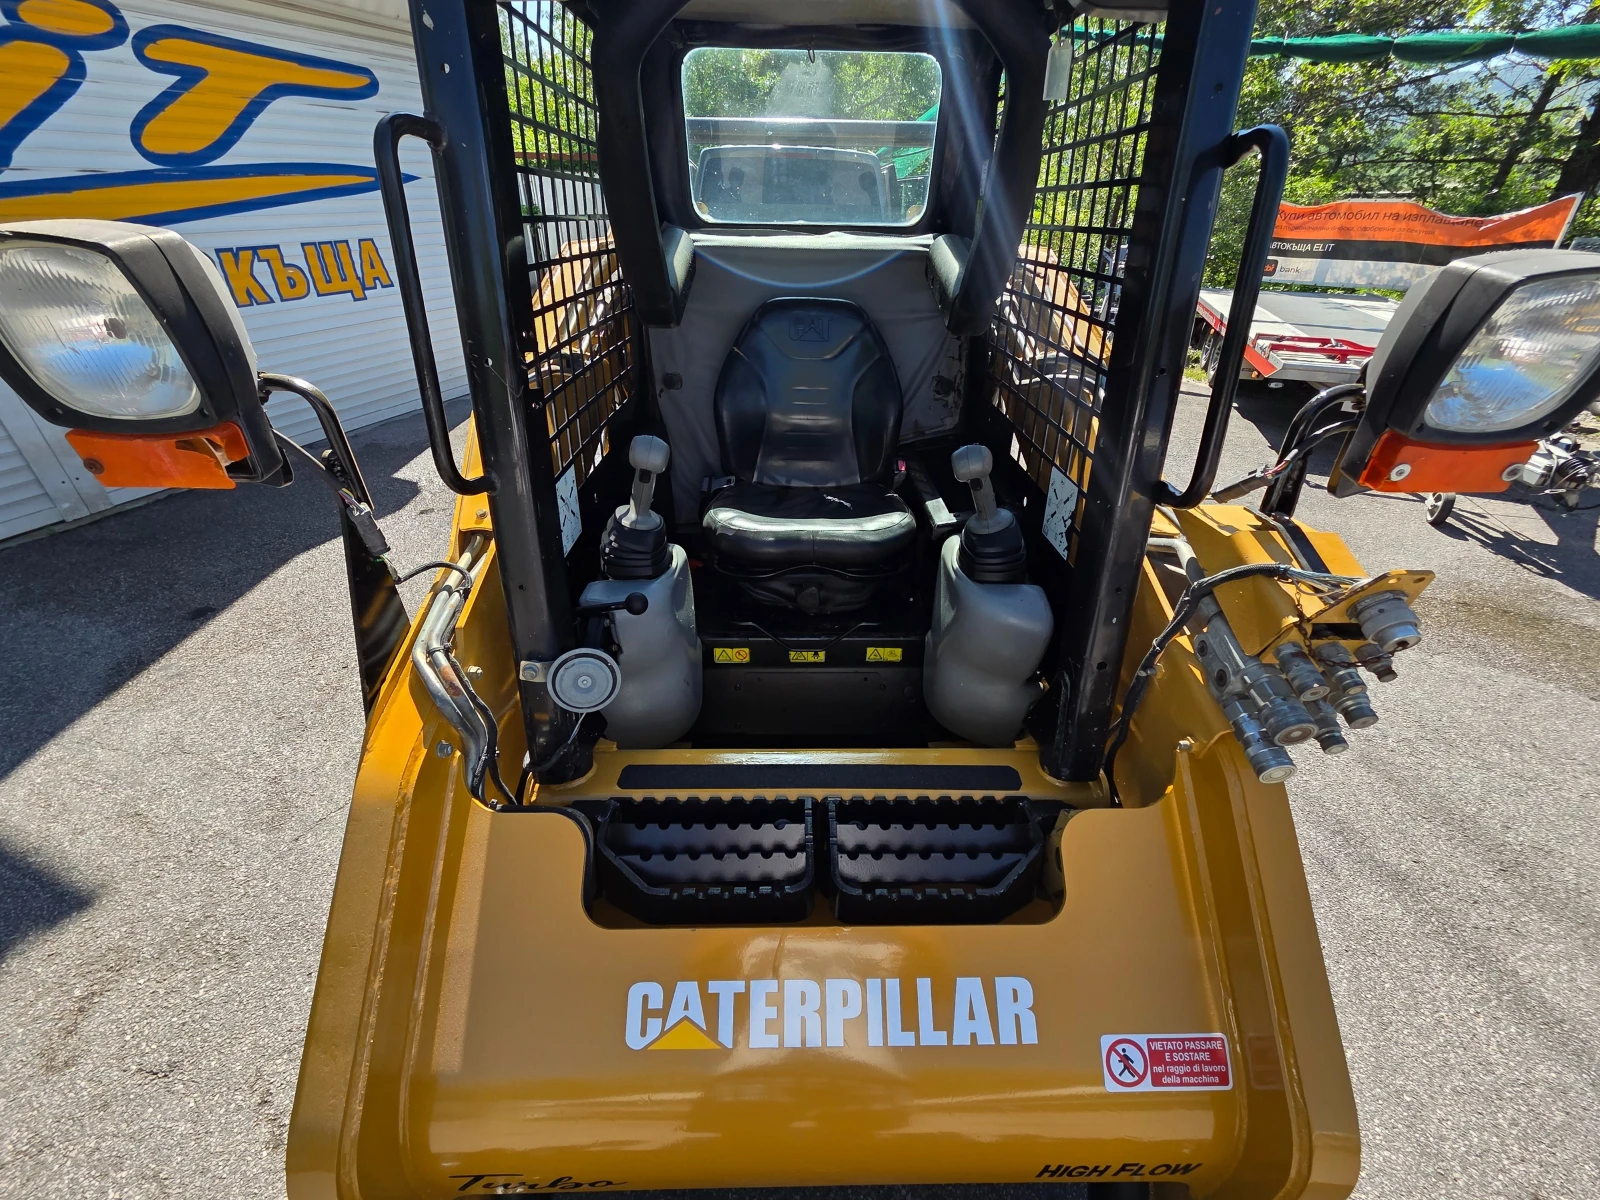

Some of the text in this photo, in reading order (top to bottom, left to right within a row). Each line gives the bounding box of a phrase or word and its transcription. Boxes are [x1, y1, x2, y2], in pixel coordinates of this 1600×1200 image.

[1308, 209, 1379, 221] автомобил
[1383, 211, 1400, 221] на
[1403, 211, 1484, 228] изплащане
[1313, 243, 1336, 252] ELIT
[206, 237, 394, 307] КЪЩА
[1280, 265, 1301, 274] bank
[625, 976, 1039, 1051] CATERPILLAR
[1149, 1040, 1223, 1051] VIETATO PASSARE
[1165, 1052, 1211, 1061] E SOSTARE
[1153, 1063, 1226, 1075] nel raggio di lavoro
[1162, 1074, 1220, 1084] della macchina
[1035, 1163, 1203, 1178] HIGH FLOW
[448, 1173, 628, 1192] Turbo
